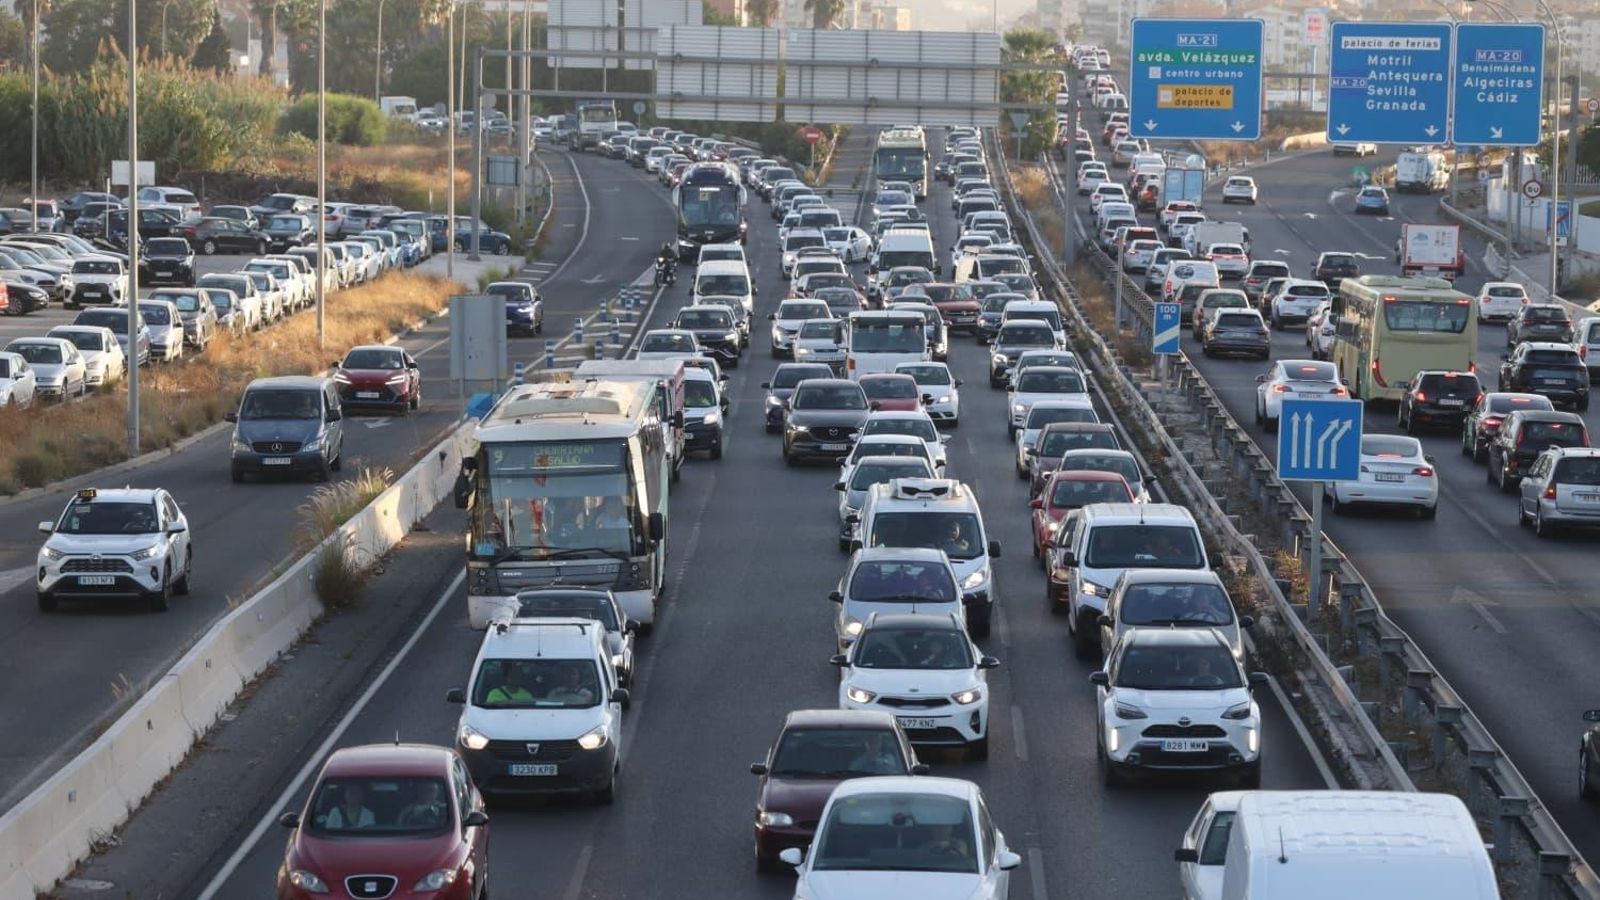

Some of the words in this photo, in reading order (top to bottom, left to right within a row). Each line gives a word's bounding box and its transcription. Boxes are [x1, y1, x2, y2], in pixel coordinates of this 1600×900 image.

[1179, 35, 1215, 45] MA-21
[1343, 39, 1382, 48] palacio
[1388, 40, 1400, 48] de
[1406, 39, 1438, 49] ferias
[1138, 52, 1174, 62] avda.
[1182, 52, 1255, 65] Velázquez
[1367, 55, 1412, 66] Motril
[1477, 51, 1520, 61] MA-20
[1166, 68, 1200, 77] centro
[1205, 68, 1244, 78] urbano
[1461, 63, 1536, 73] Benalmádena
[1368, 70, 1443, 83] Antequera
[1464, 76, 1533, 90] Algeciras
[1175, 87, 1214, 96] palacio
[1219, 87, 1231, 96] de
[1367, 85, 1416, 96] Sevilla
[1476, 91, 1518, 103] Cádiz
[1175, 98, 1221, 107] deportes
[1366, 99, 1426, 111] Granada
[1160, 305, 1177, 313] 100
